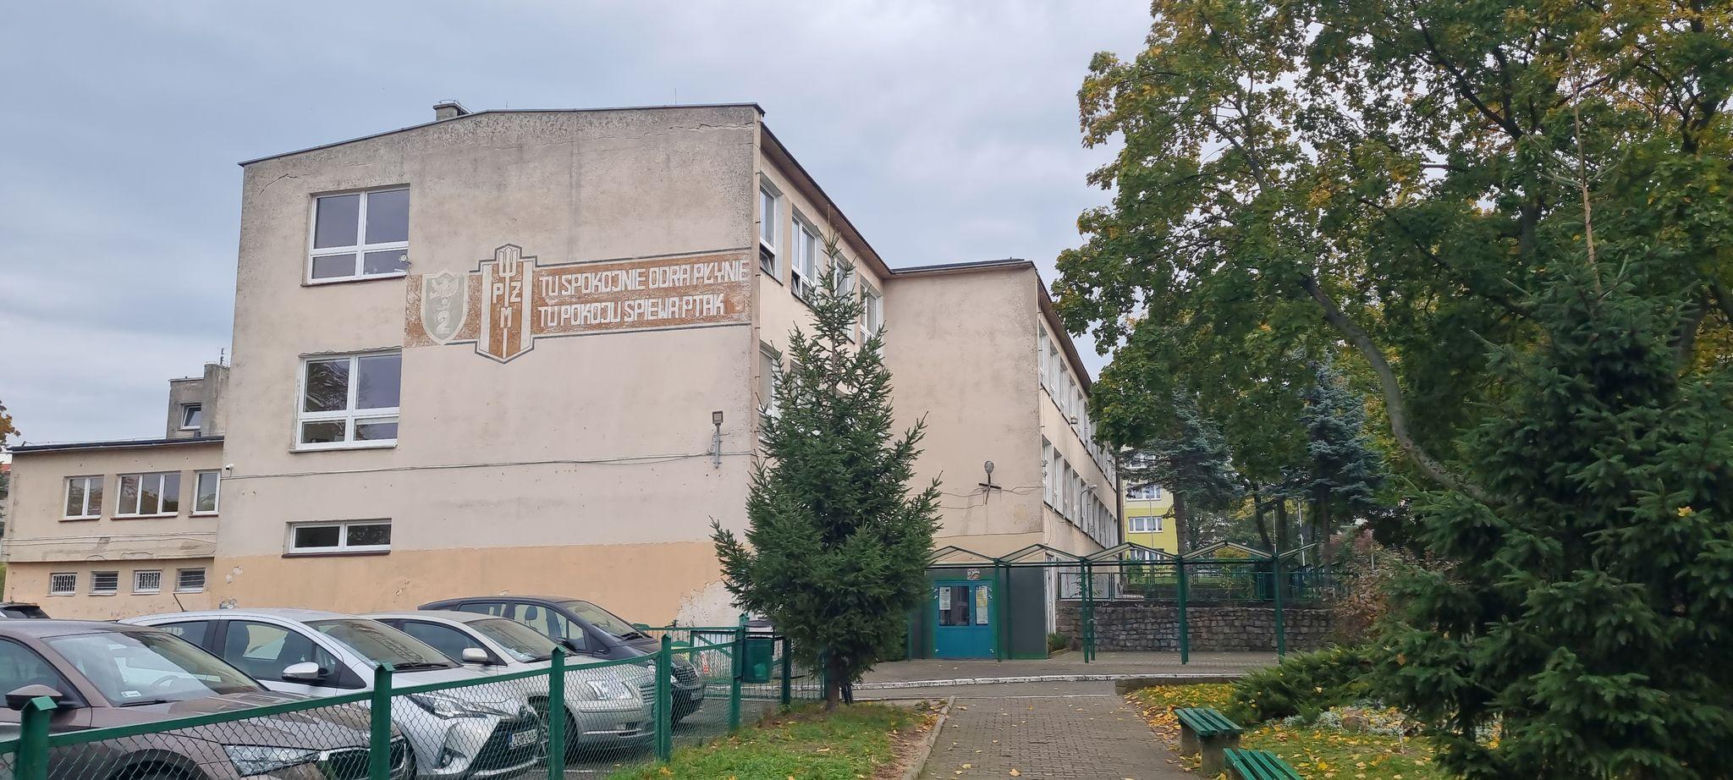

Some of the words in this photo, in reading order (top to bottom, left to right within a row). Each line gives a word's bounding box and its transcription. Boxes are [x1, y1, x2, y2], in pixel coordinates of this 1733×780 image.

[538, 275, 559, 297] TU
[561, 269, 646, 295] SPOKOJNIE
[648, 264, 690, 289] ODRA
[437, 310, 451, 334] 2
[538, 304, 558, 328] TU
[560, 300, 621, 327] POKOJU
[682, 293, 725, 318] PTAK
